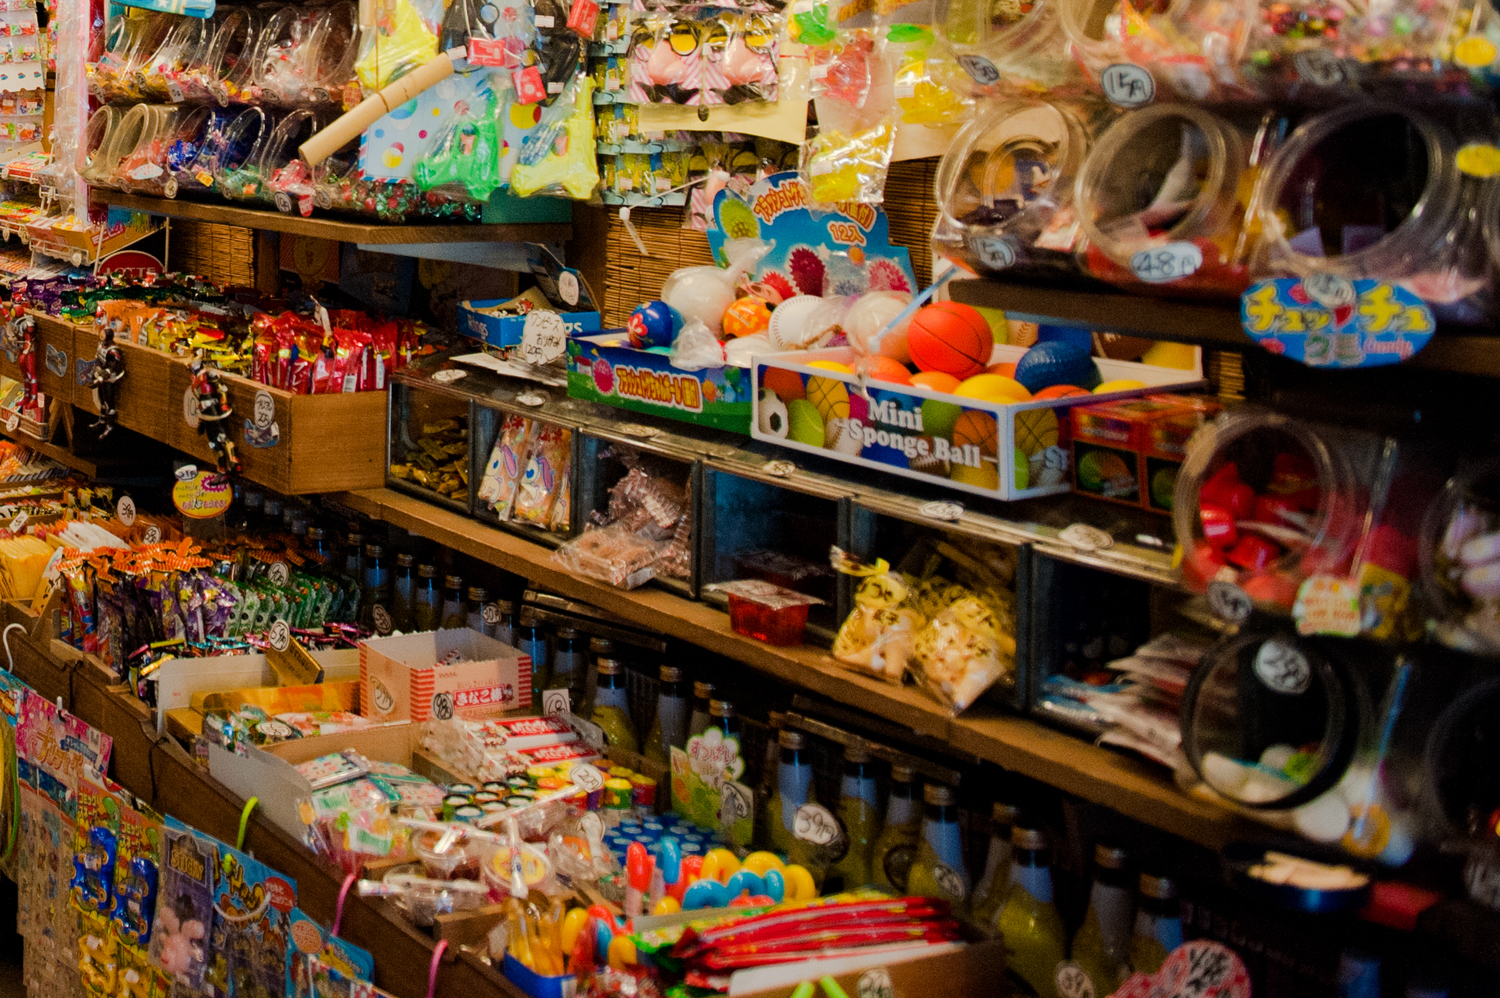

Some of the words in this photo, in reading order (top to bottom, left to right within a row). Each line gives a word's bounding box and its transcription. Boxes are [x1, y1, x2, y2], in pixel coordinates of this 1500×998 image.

[830, 222, 864, 245] 12入
[467, 315, 488, 338] Rings
[868, 400, 923, 432] Mini
[848, 419, 930, 459] Sponge
[932, 436, 981, 470] Ball
